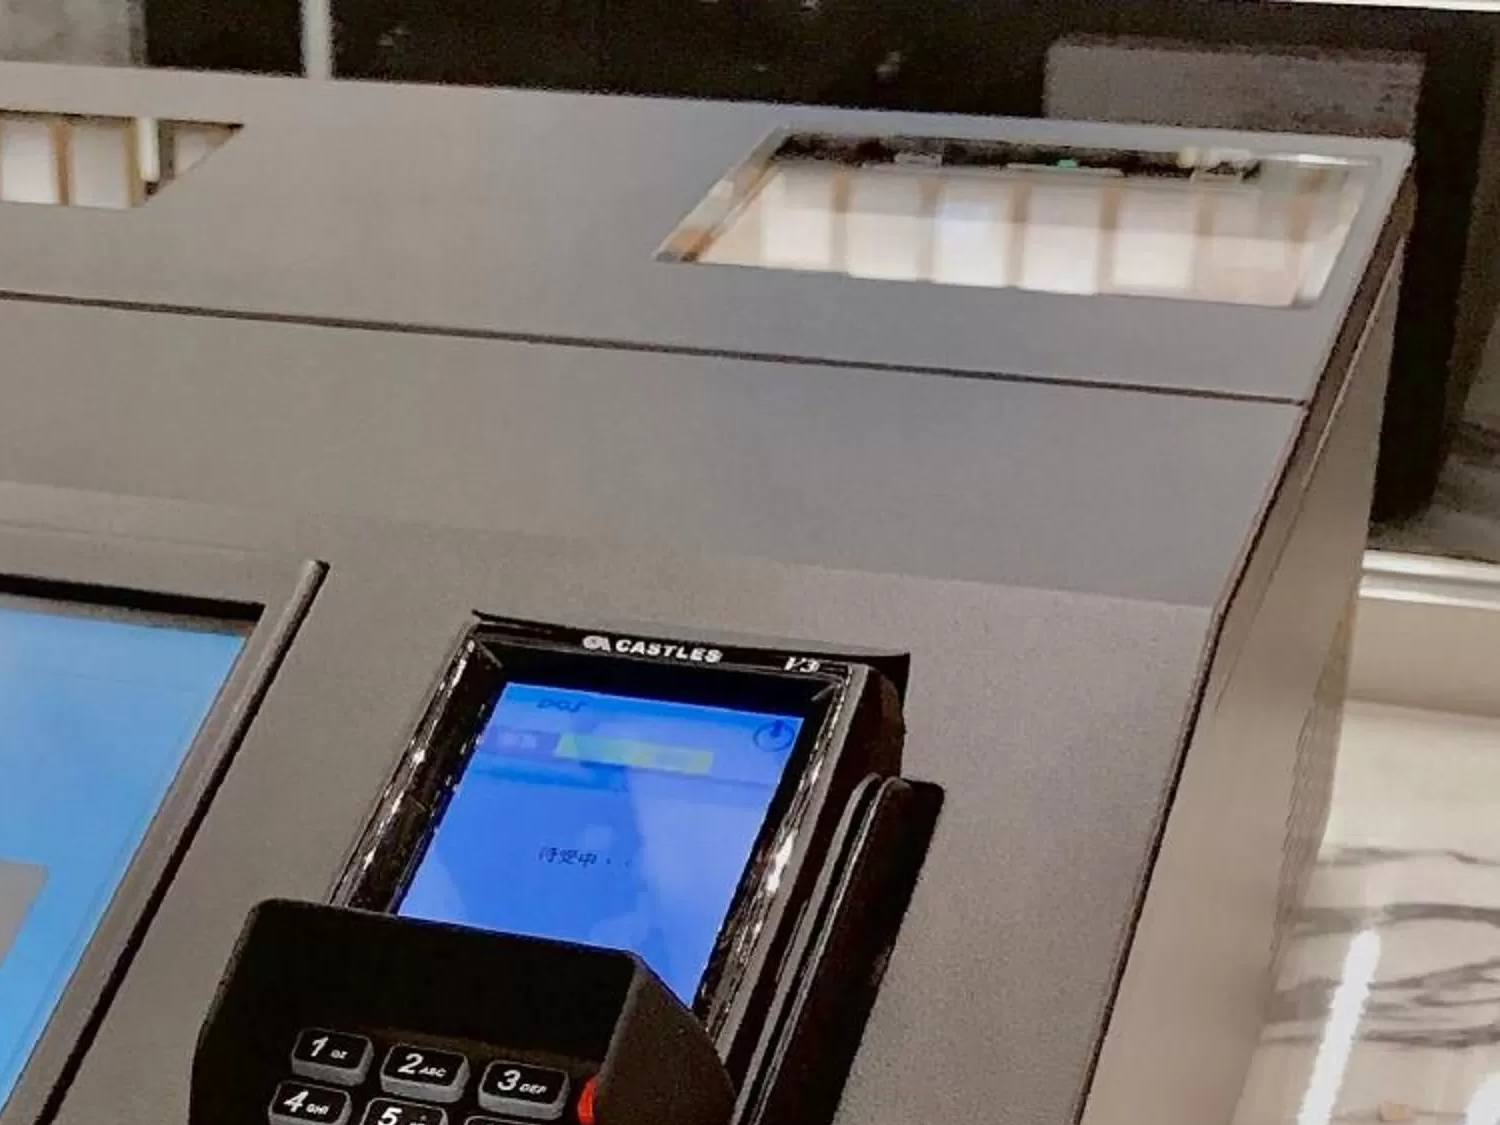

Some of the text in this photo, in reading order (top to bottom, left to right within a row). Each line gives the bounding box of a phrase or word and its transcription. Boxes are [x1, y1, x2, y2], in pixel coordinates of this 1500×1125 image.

[615, 639, 724, 664] CASTLES
[311, 1036, 329, 1057] 1
[397, 1053, 425, 1075] 2
[497, 1069, 521, 1091] 3
[283, 1090, 309, 1113] 4
